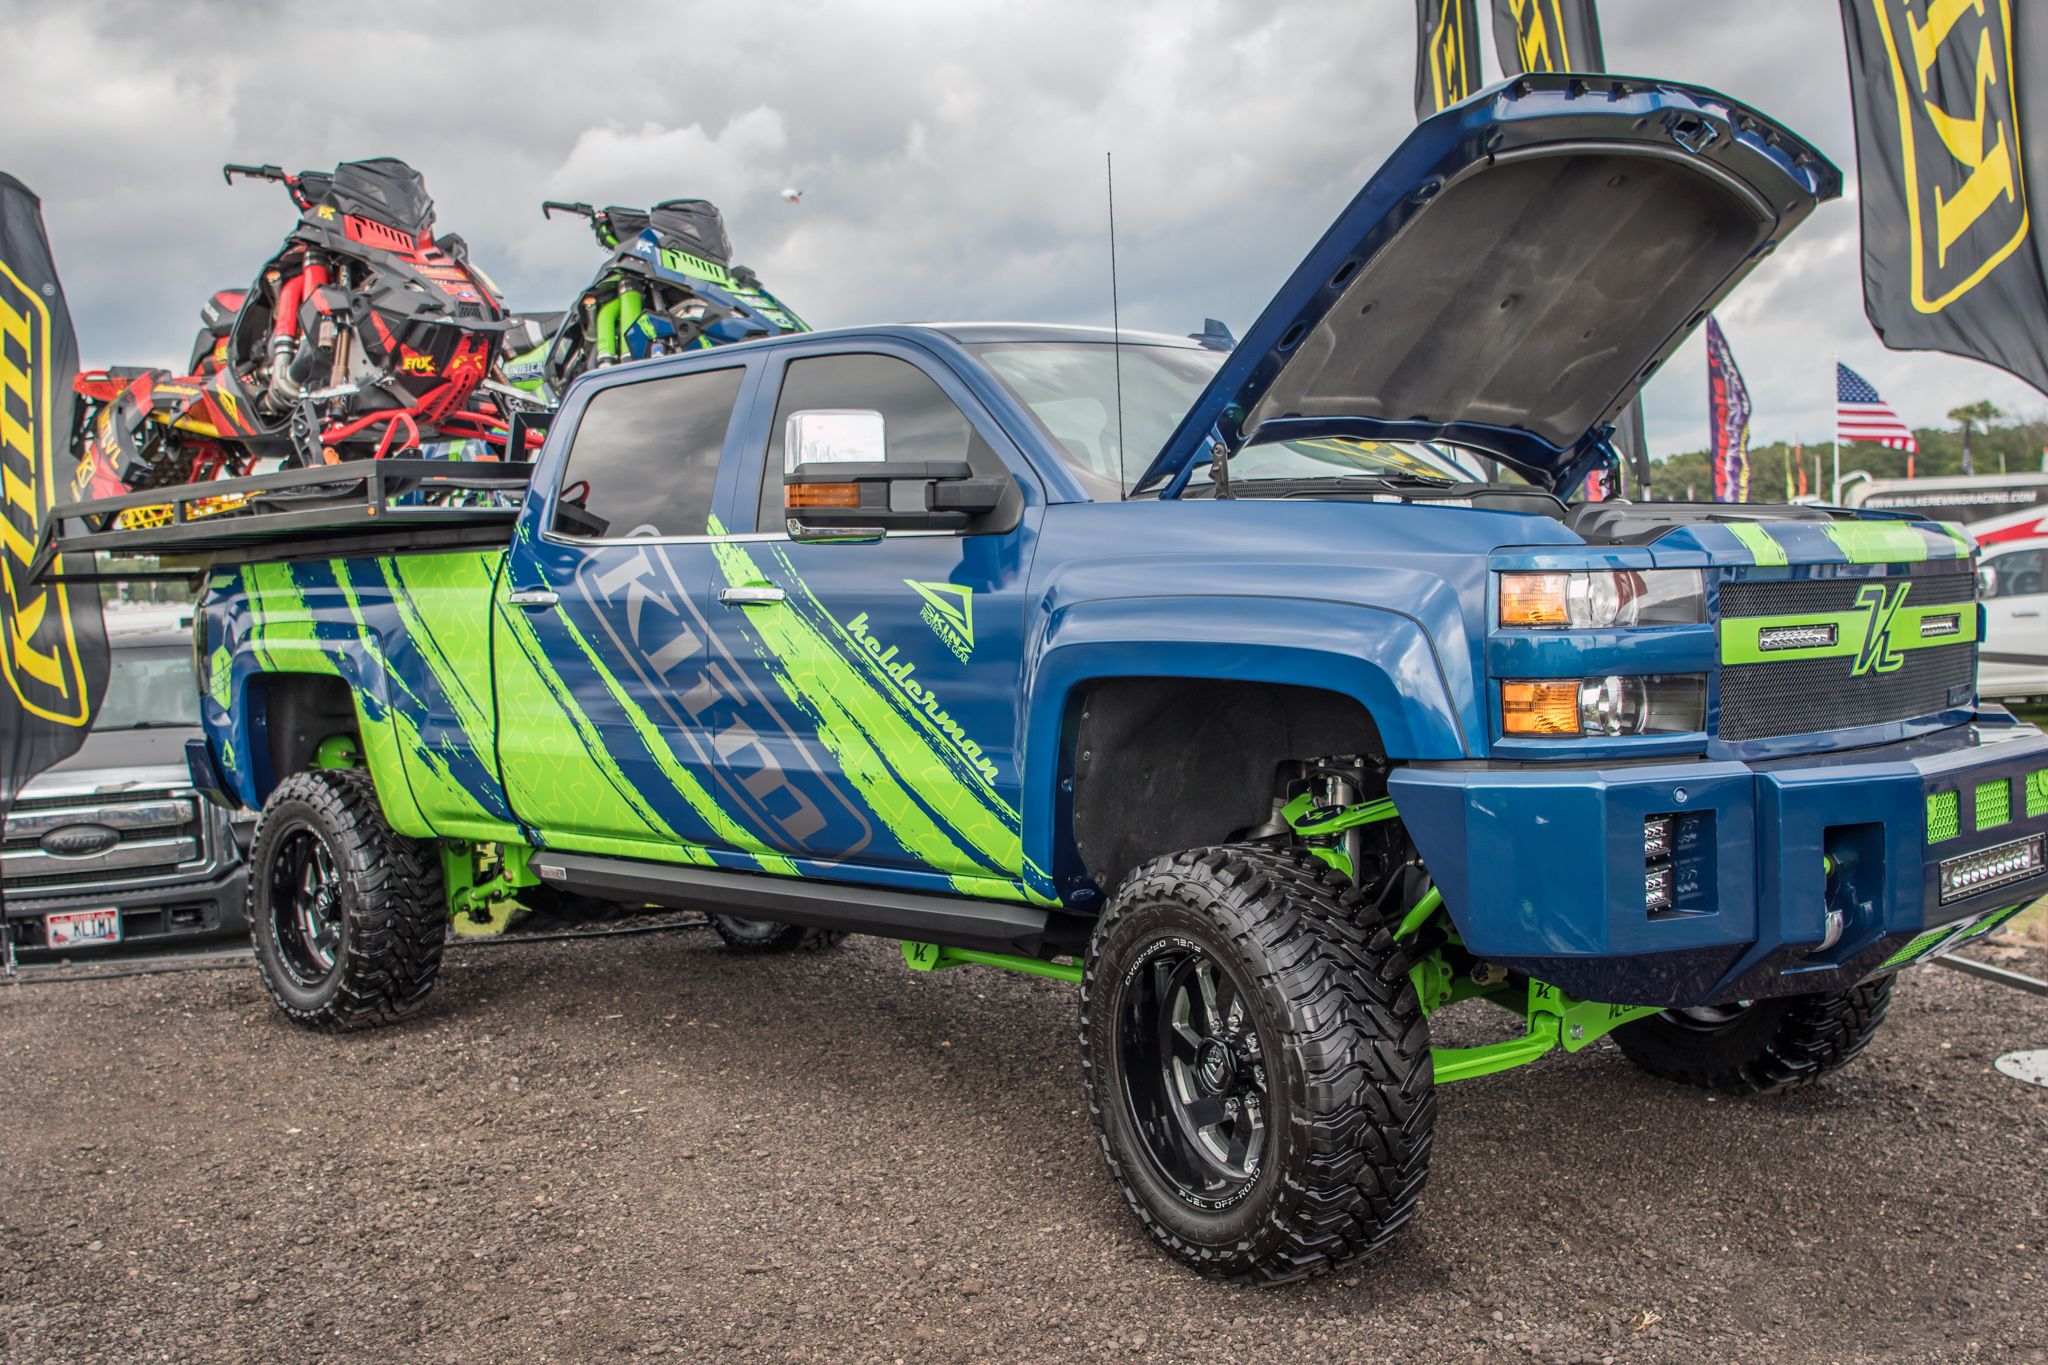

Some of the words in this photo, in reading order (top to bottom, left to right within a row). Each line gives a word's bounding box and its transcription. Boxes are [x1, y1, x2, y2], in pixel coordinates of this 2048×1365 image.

[919, 608, 953, 648] PROTECTIVE
[951, 645, 970, 666] GEAR
[924, 602, 973, 653] SKINZ
[847, 612, 999, 786] kelderman
[1125, 939, 1166, 986] OFF-ROAD
[1172, 938, 1202, 953] FUEL
[1178, 1189, 1208, 1209] FUEL
[1214, 1167, 1261, 1209] OFF-ROAD
